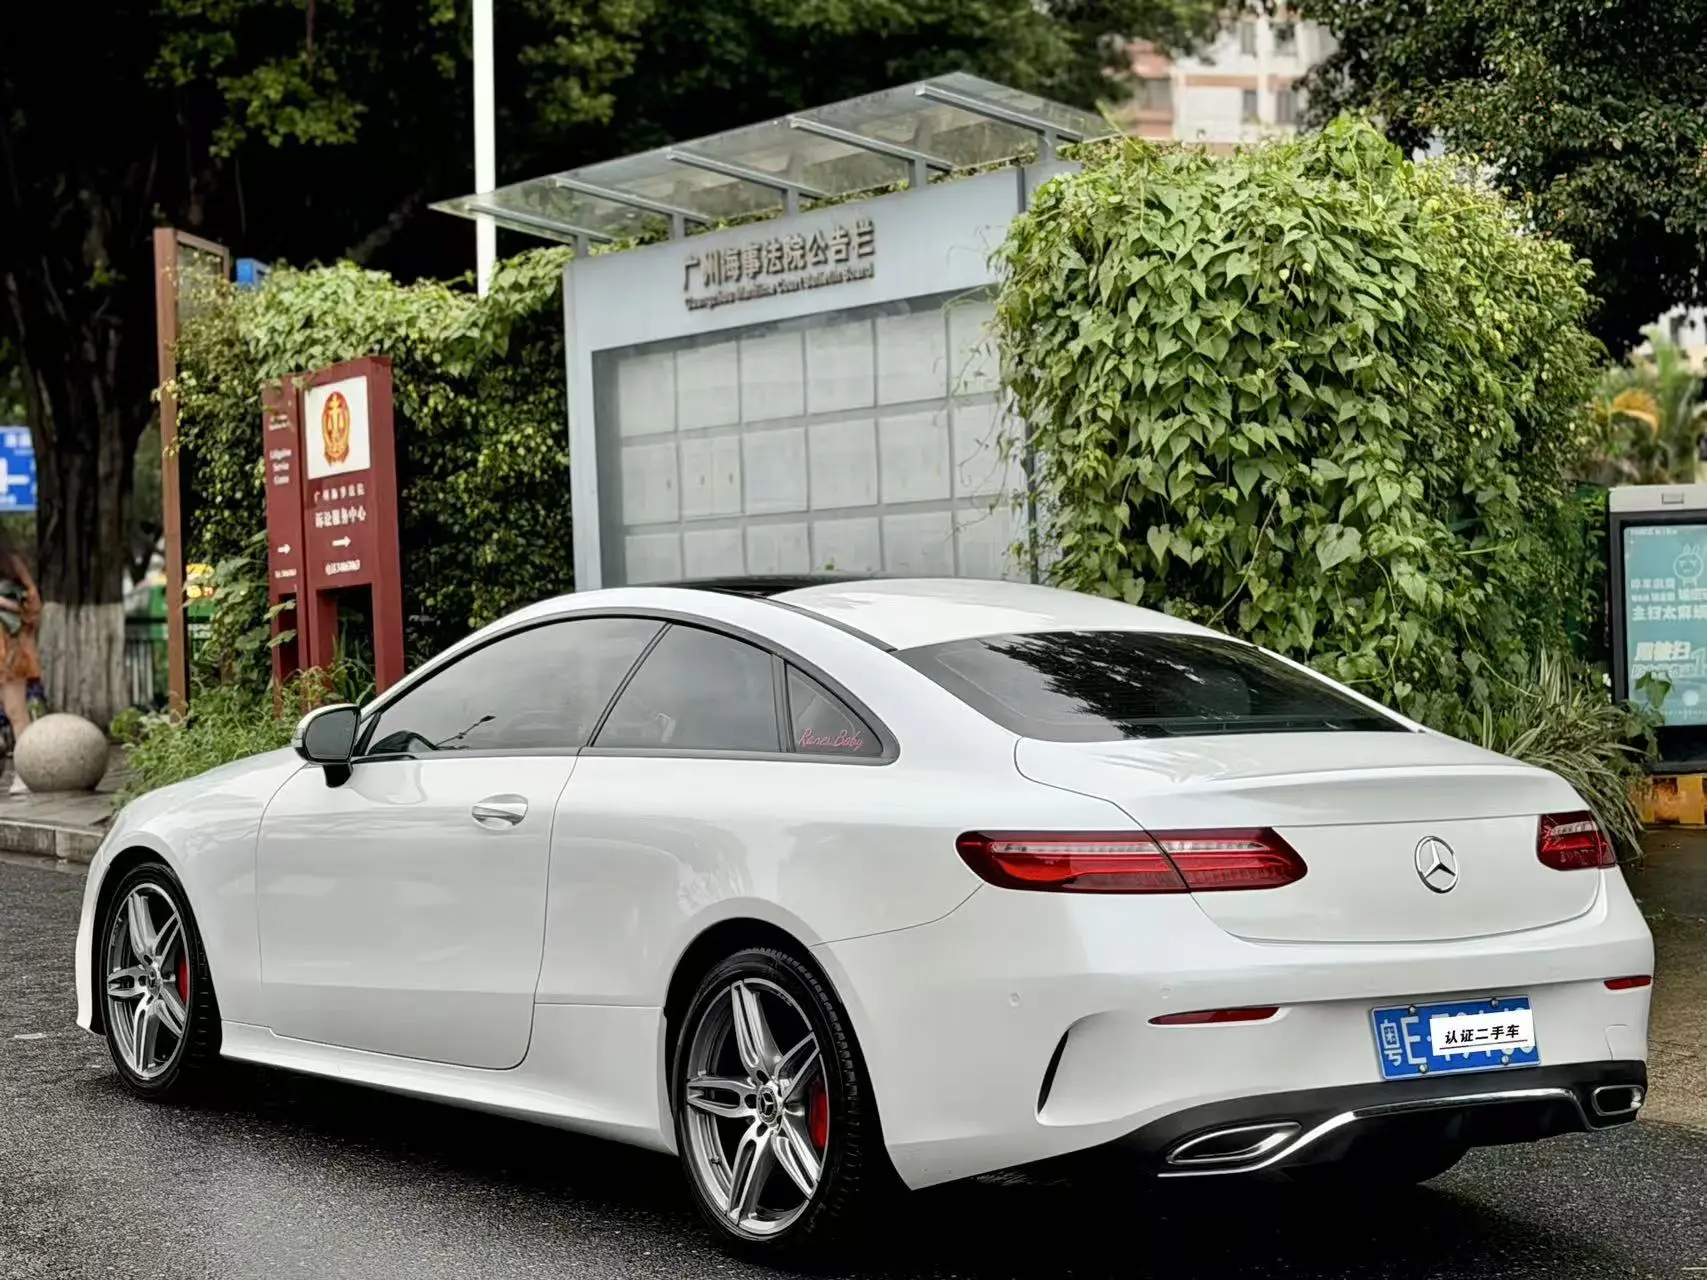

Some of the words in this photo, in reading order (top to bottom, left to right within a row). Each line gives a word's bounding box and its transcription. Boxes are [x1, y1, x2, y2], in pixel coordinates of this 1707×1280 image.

[684, 216, 876, 292] 广州海事法院公告栏
